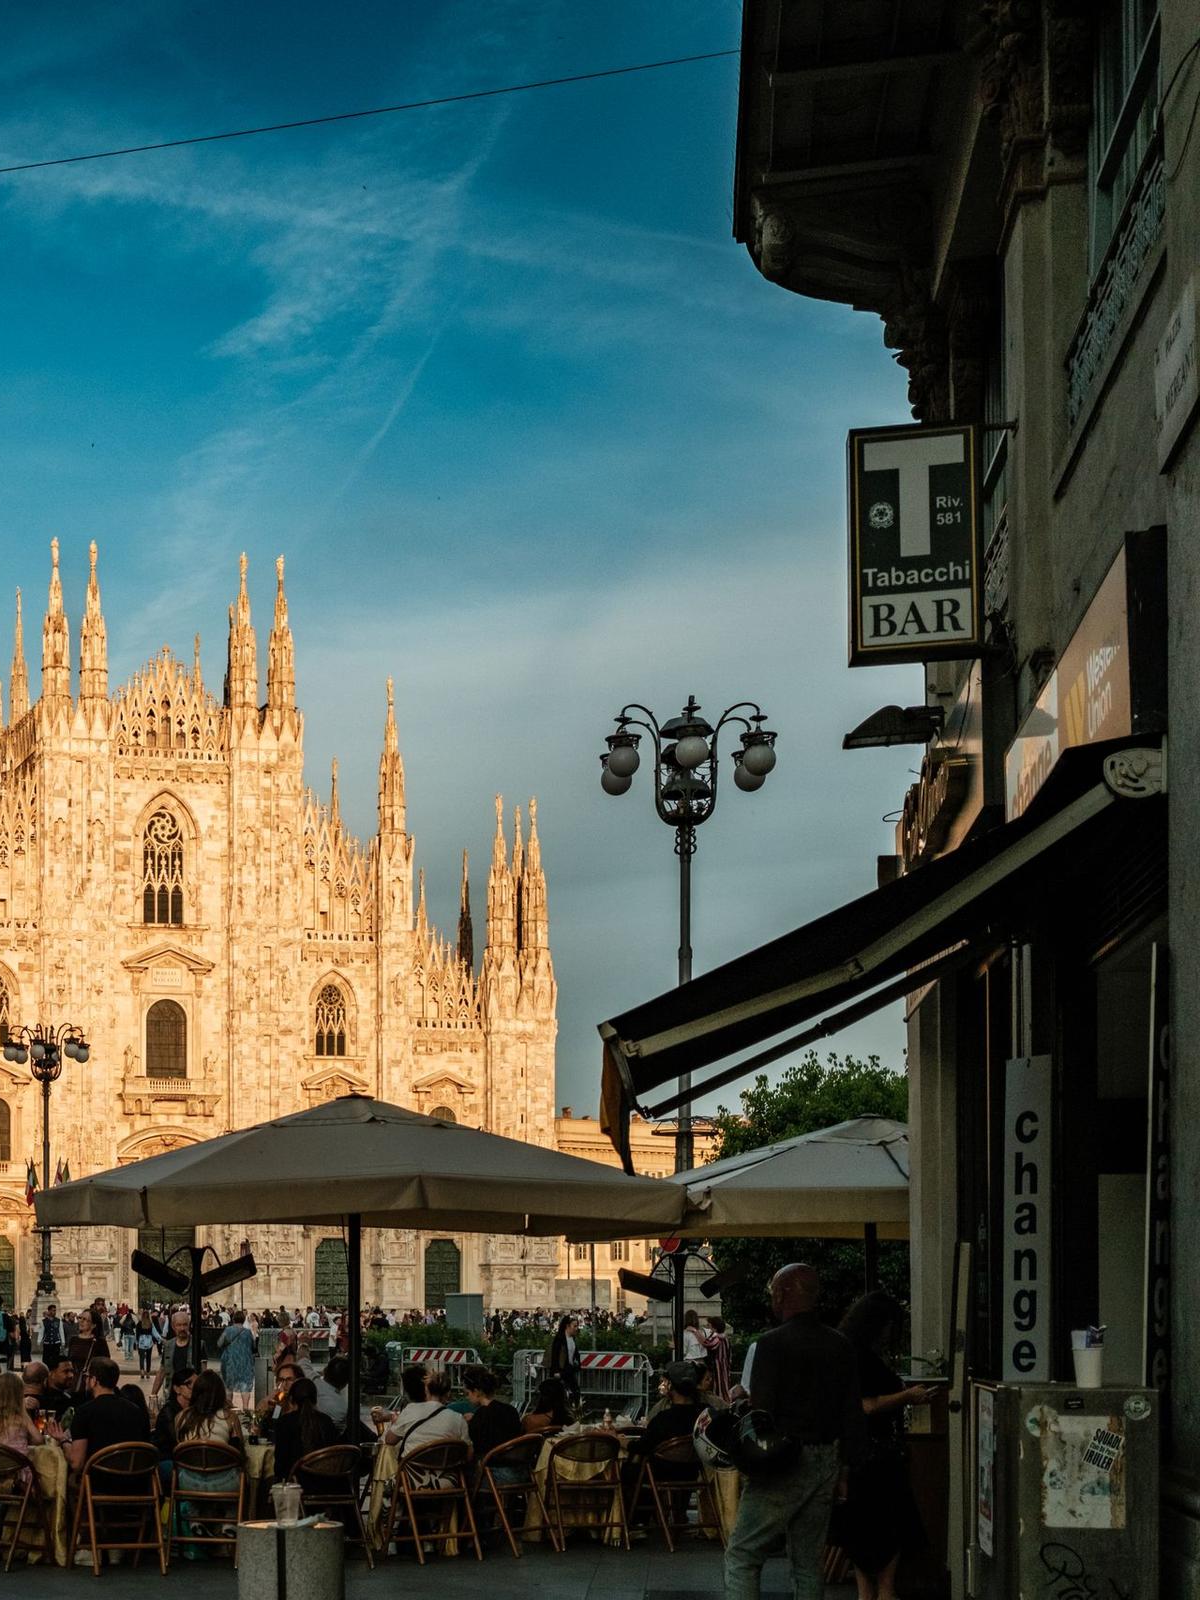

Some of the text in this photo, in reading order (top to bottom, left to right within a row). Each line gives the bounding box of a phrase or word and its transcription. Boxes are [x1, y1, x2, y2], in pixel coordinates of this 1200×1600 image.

[863, 434, 965, 558] T
[935, 495, 964, 510] Riv.
[936, 511, 962, 526] 581
[863, 560, 971, 588] Tabacchi
[868, 597, 966, 639] BAR
[1088, 680, 1113, 739] Union
[1013, 1110, 1039, 1373] change
